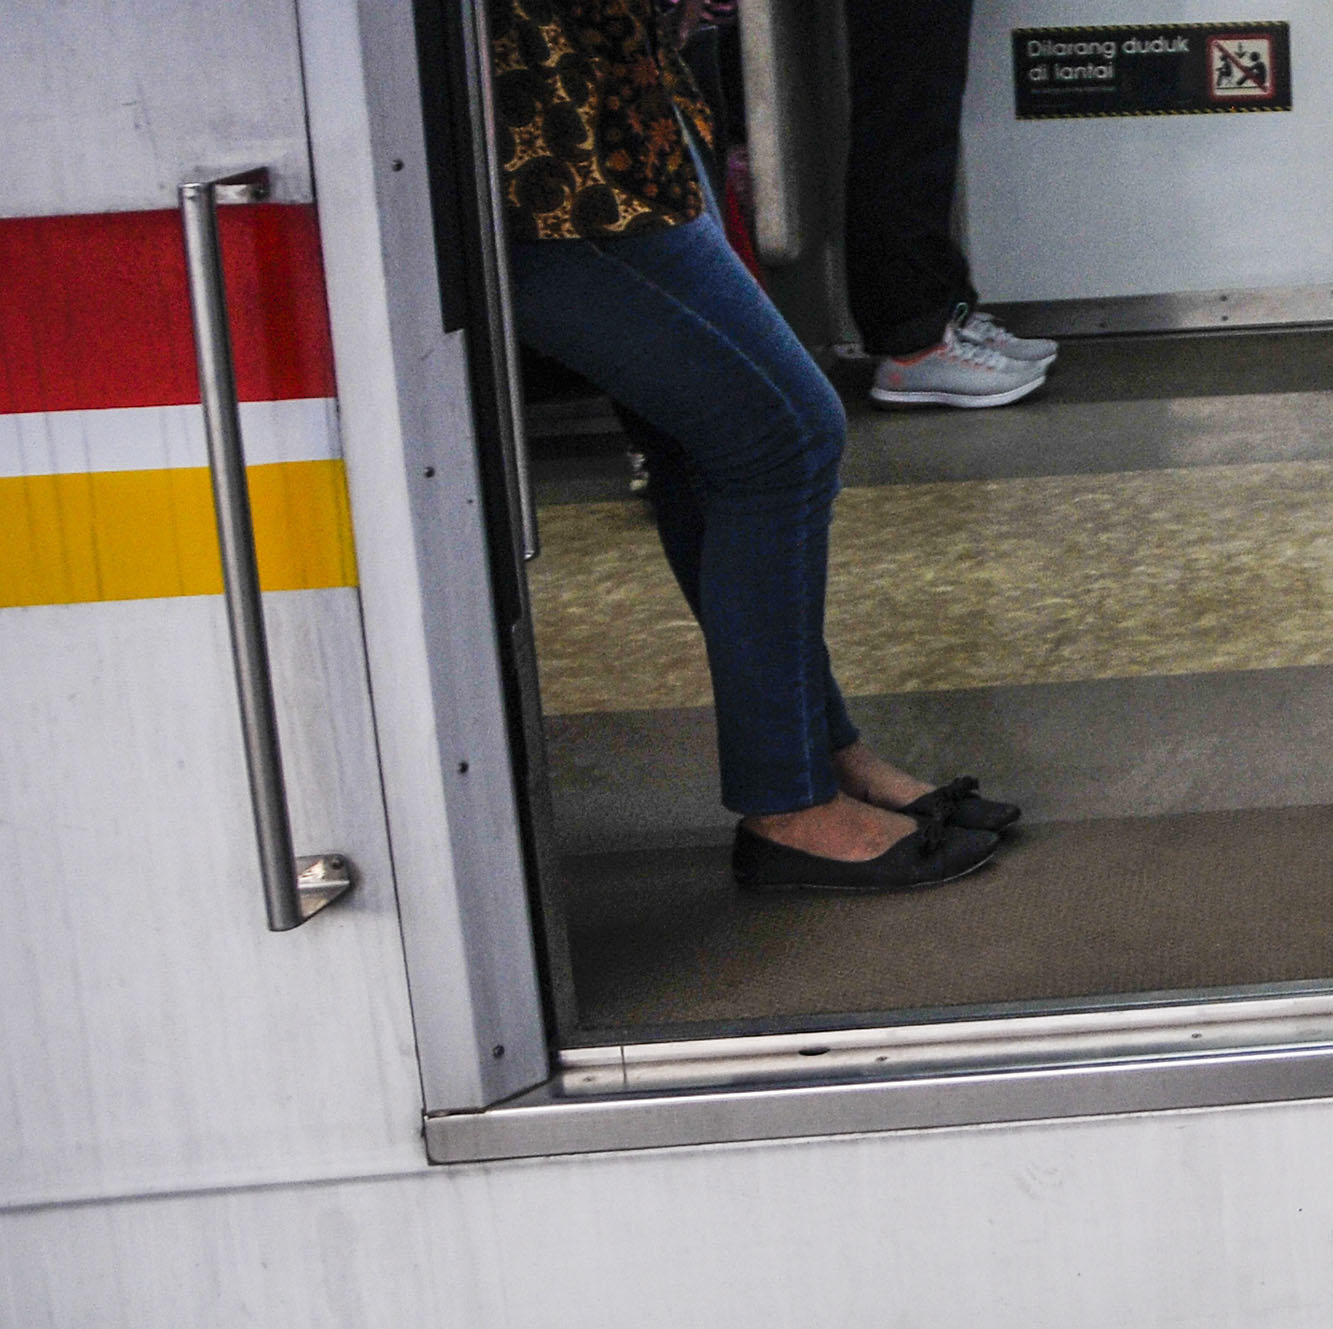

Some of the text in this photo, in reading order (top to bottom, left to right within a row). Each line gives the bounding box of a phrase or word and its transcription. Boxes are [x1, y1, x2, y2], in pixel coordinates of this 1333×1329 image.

[1027, 35, 1190, 59] Dilarang duduk
[1029, 61, 1114, 82] di lantai
